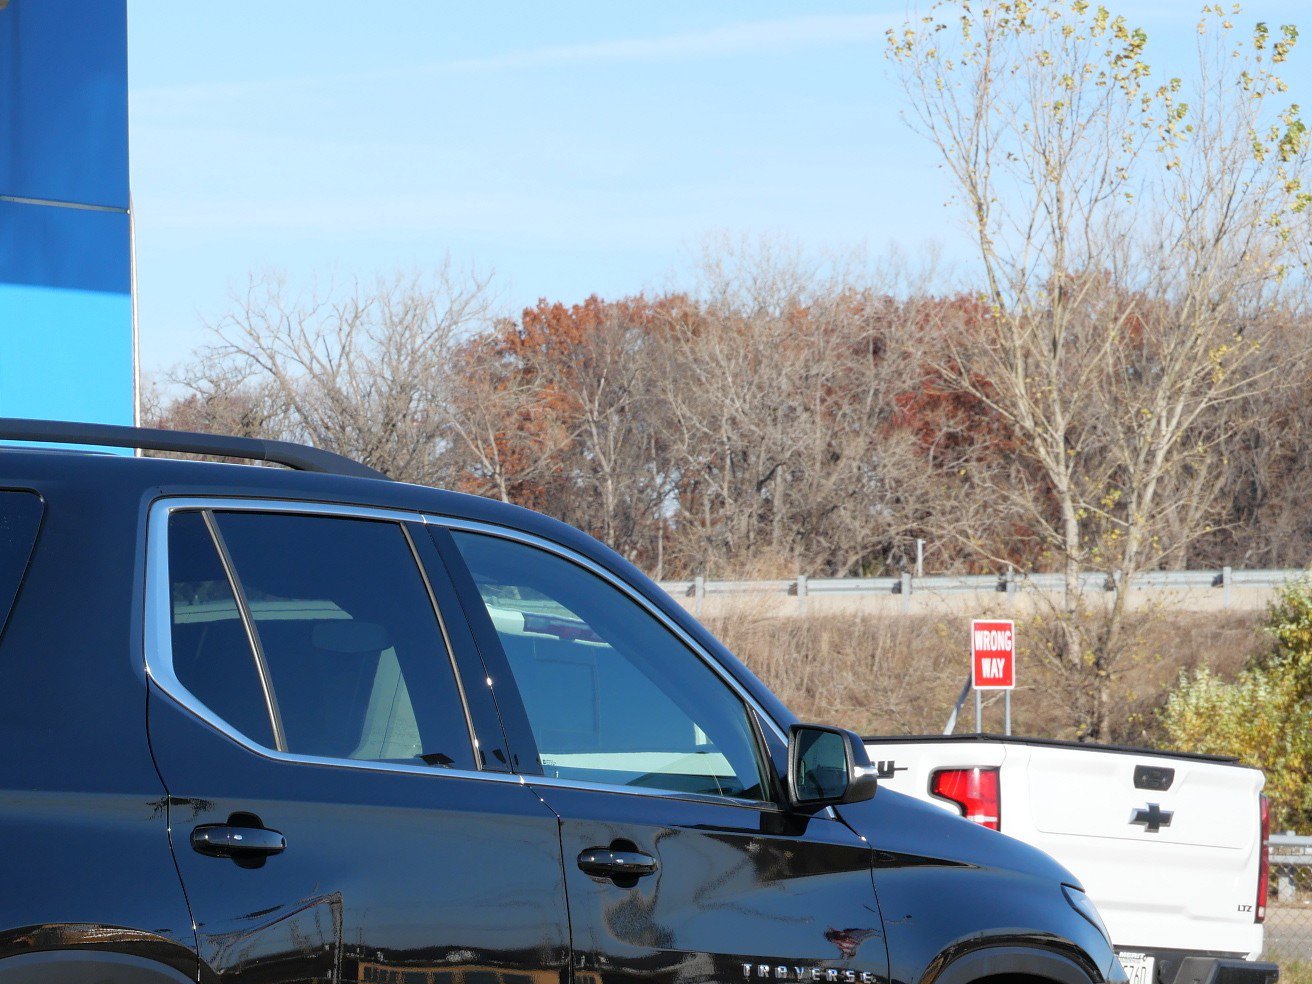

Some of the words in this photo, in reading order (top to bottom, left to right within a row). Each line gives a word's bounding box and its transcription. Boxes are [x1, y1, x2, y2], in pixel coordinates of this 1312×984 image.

[974, 630, 1012, 651] WRONG
[981, 658, 1005, 678] WAY
[1237, 904, 1252, 912] LTZ
[742, 963, 873, 984] TRAVERSE
